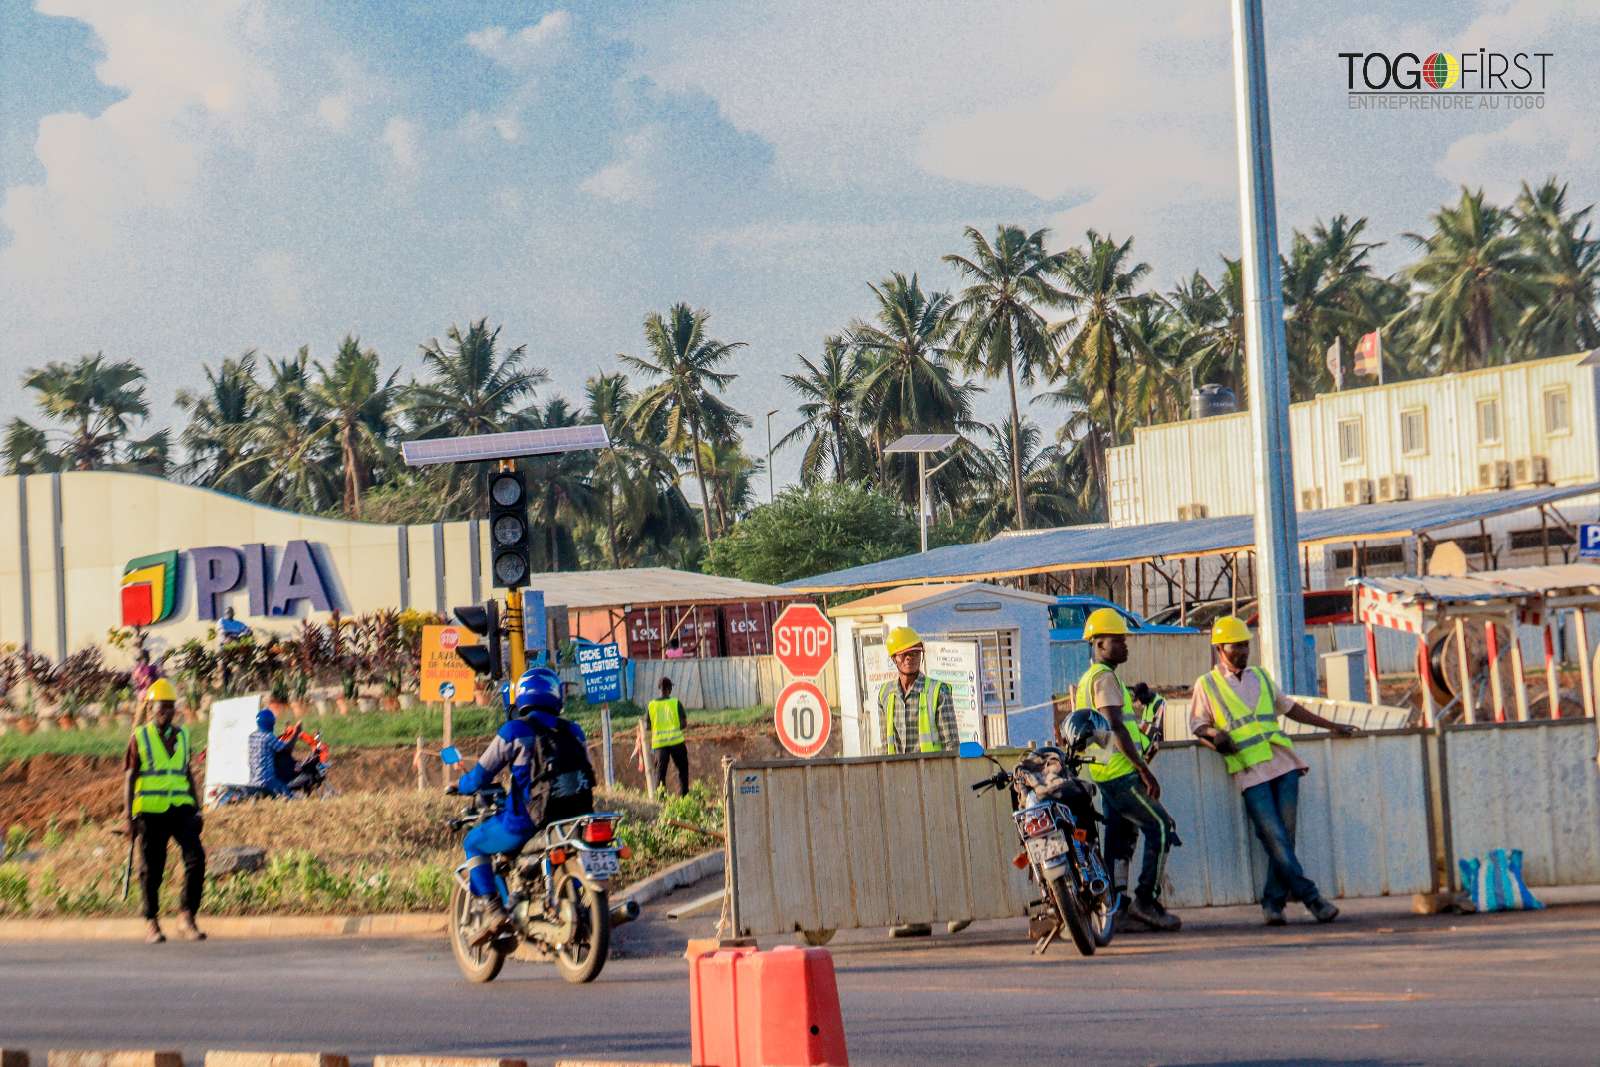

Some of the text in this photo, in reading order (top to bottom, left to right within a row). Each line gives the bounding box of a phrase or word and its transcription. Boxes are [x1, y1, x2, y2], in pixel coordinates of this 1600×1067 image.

[189, 540, 334, 620] PIA
[731, 618, 758, 634] tex
[579, 645, 617, 662] CACHE NEZ
[777, 626, 829, 657] STOP
[580, 658, 619, 674] OBLIGATOIRE
[791, 707, 815, 740] 10
